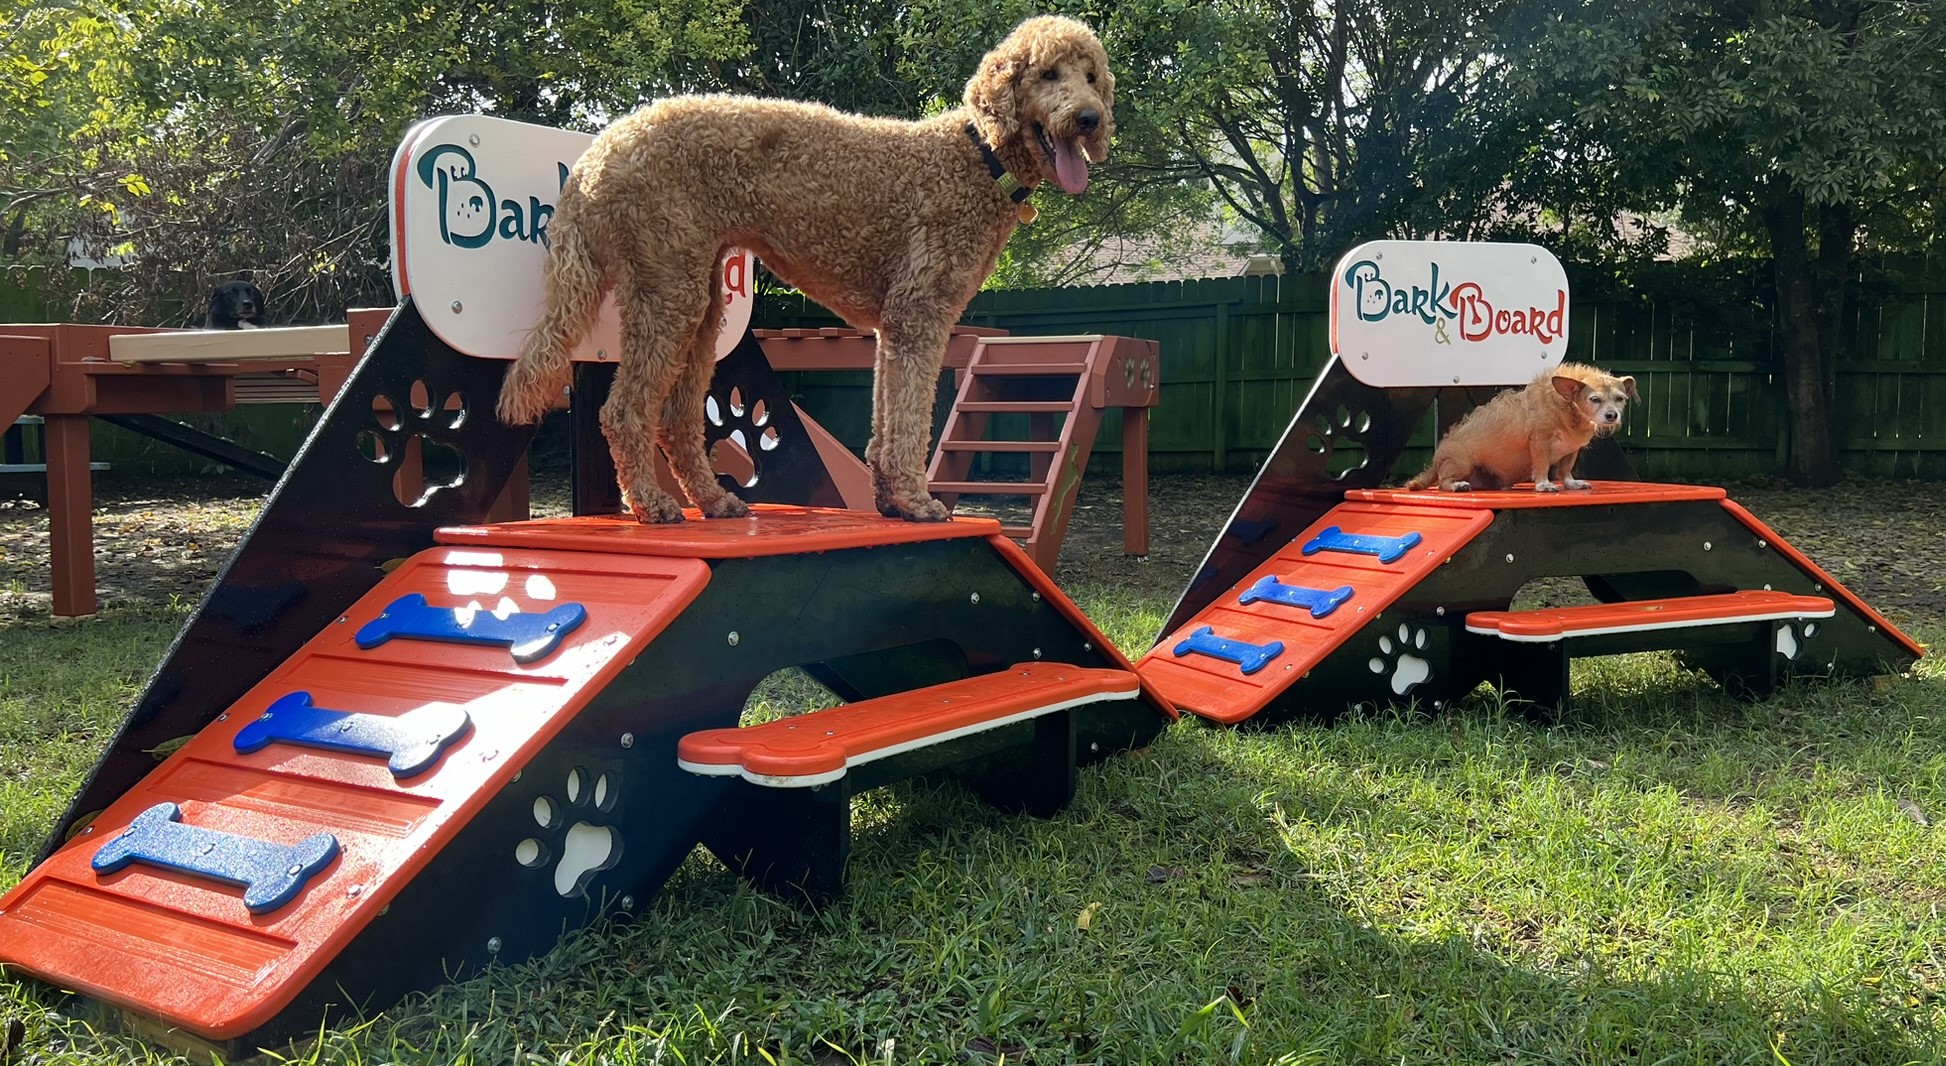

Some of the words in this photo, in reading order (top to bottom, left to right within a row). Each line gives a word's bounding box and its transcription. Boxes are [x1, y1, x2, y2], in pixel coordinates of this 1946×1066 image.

[417, 143, 569, 254] Bar
[1345, 260, 1457, 325] Bark
[1434, 317, 1451, 345] &
[1449, 282, 1566, 345] Board
